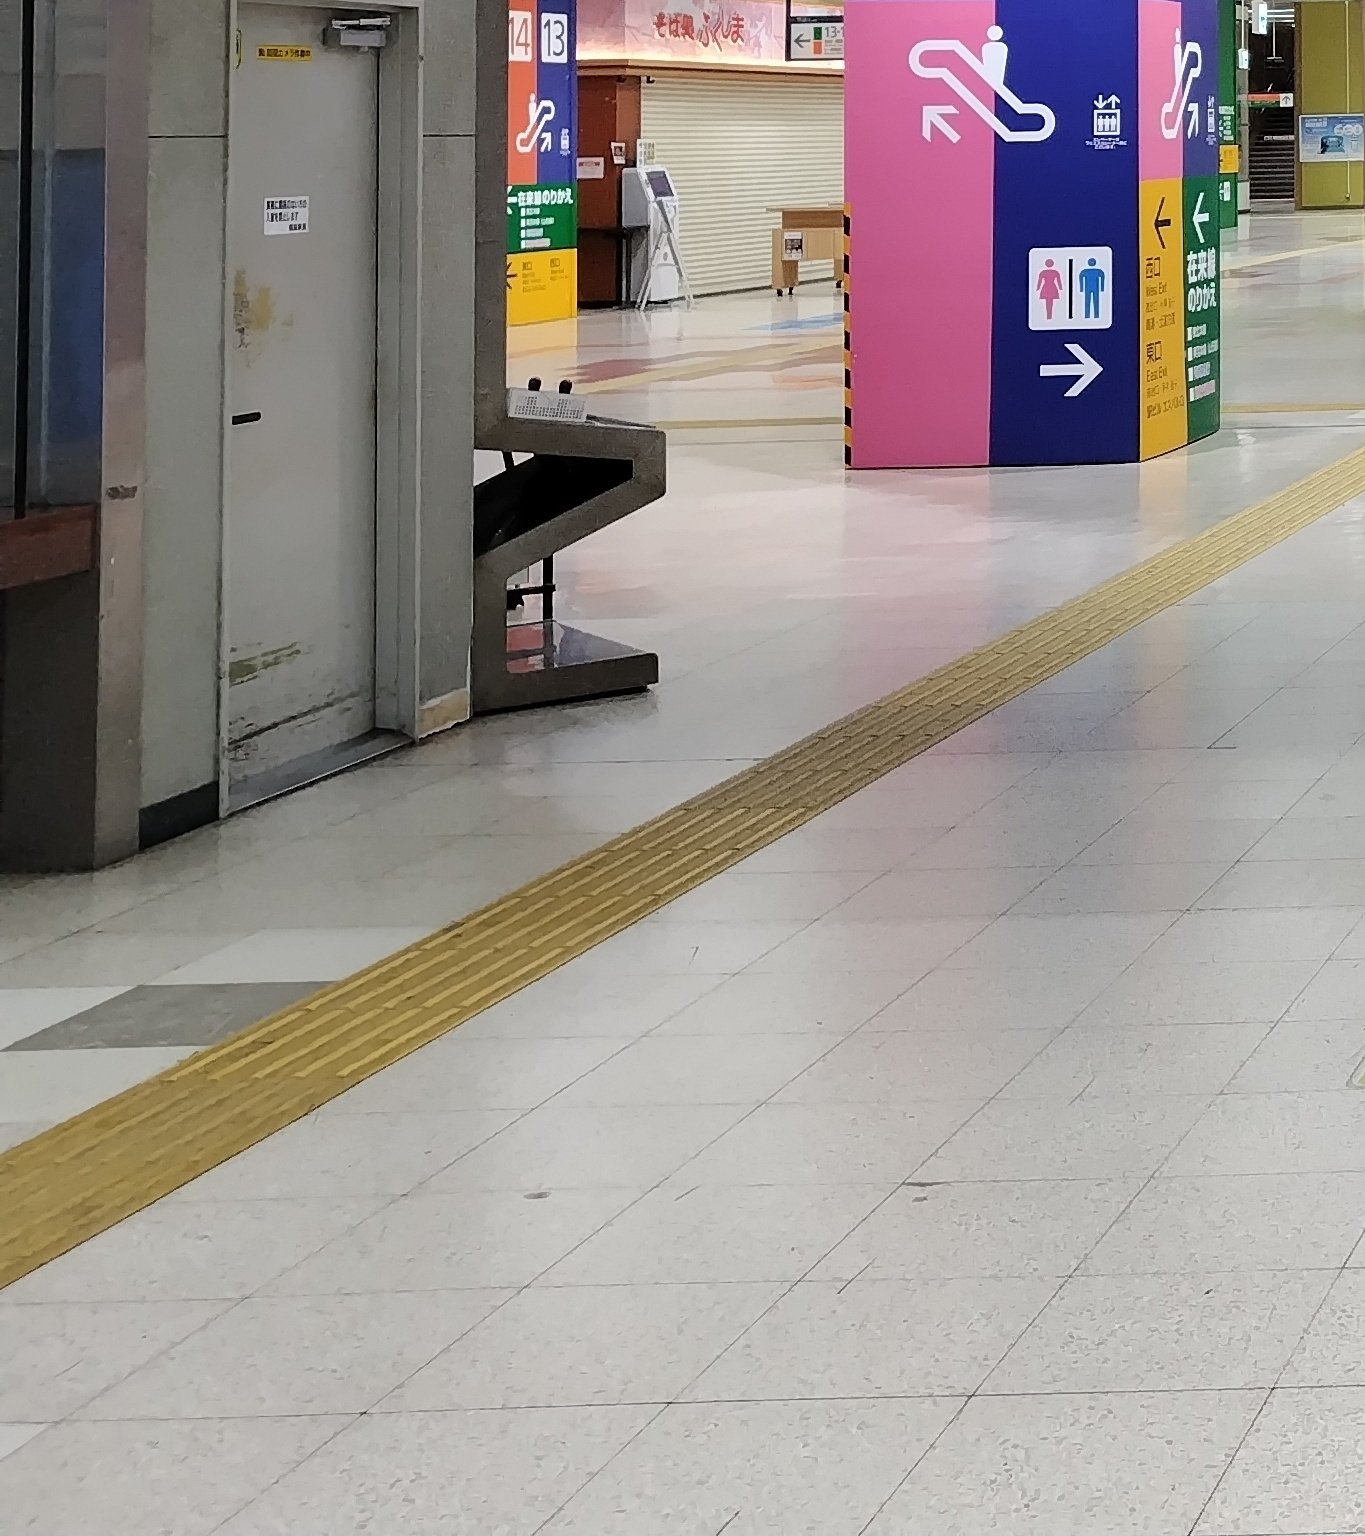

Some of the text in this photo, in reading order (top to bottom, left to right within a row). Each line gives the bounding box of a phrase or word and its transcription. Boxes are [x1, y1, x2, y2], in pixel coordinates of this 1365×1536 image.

[509, 17, 530, 55] 14
[544, 19, 564, 56] 13
[1187, 247, 1216, 284] 在来線
[1188, 282, 1216, 312] のりかえ
